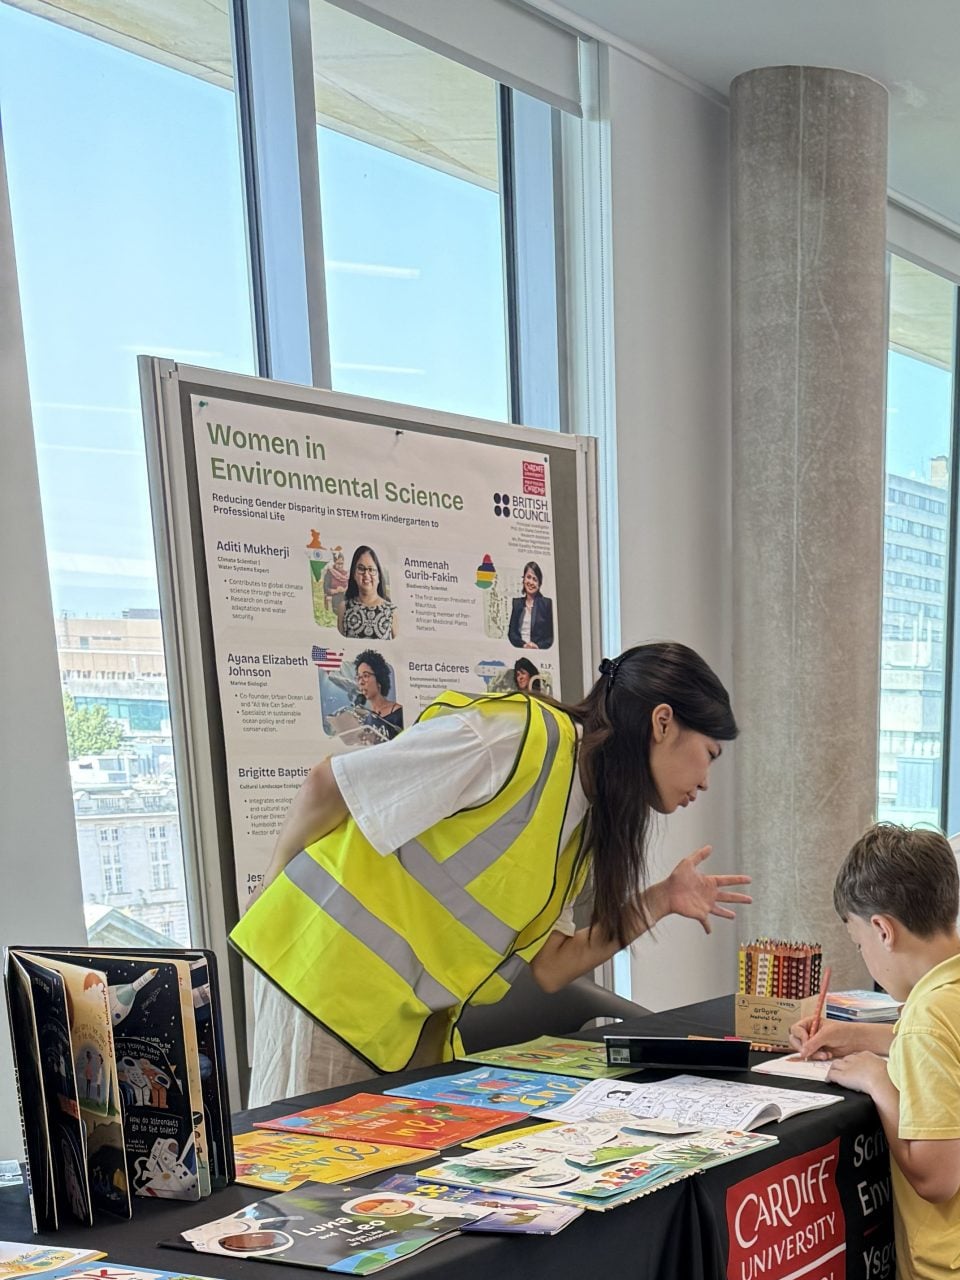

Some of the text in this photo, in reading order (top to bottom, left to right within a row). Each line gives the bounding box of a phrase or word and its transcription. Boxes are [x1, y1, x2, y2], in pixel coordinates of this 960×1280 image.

[207, 422, 326, 460] Women in
[211, 457, 463, 510] Environmental Science
[212, 493, 439, 528] Reducing Gender Disparity in STEM from Kindergarten to
[513, 496, 548, 510] BRITISH
[213, 505, 285, 521] Professional Life
[513, 508, 551, 523] COUNCIL
[216, 540, 290, 559] Aditi Mukherji
[404, 557, 449, 570] Ammenah
[404, 569, 458, 583] Gurib-Fakim
[229, 578, 260, 588] Contributes
[268, 582, 283, 590] global
[230, 595, 255, 603] Research
[227, 653, 308, 666] Ayana Elizabeth
[409, 661, 469, 673] Berta Cáceres
[228, 666, 271, 677] Johnson
[238, 766, 312, 779] Brigitte Baptis
[305, 1145, 380, 1167] me
[734, 1154, 835, 1249] CARDIFF
[292, 1217, 354, 1236] Luna
[339, 1220, 386, 1235] Leo
